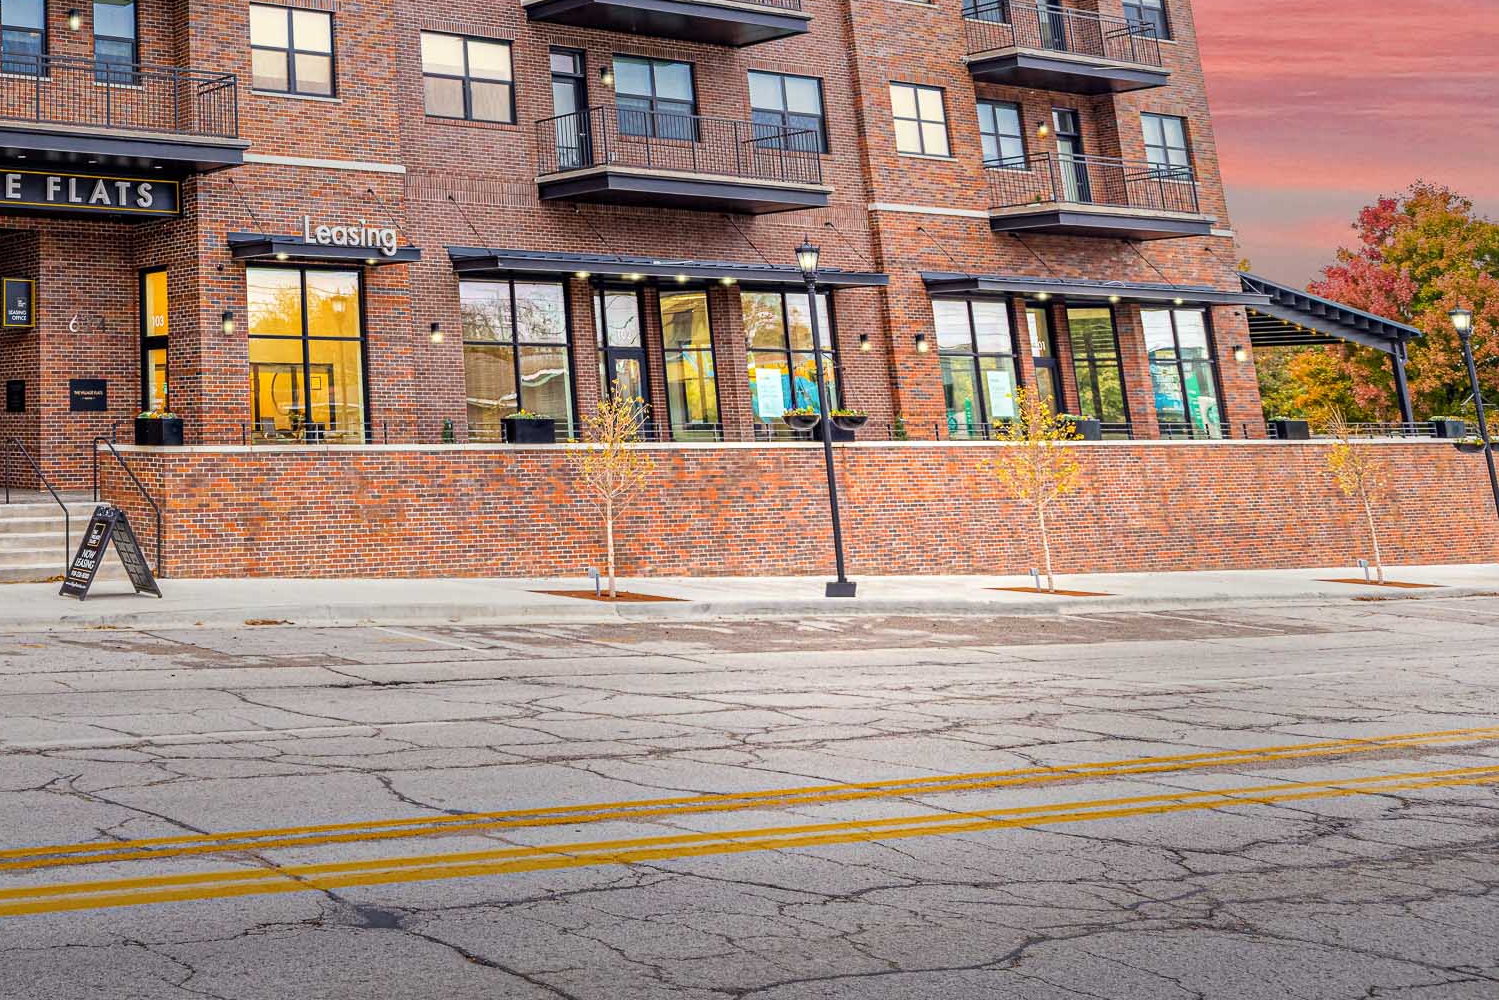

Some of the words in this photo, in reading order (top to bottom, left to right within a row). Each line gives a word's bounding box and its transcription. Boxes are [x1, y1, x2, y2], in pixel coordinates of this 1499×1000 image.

[46, 176, 154, 208] FLATS
[304, 215, 397, 257] Leasing
[152, 315, 165, 327] 103
[82, 549, 97, 560] NOW
[74, 557, 95, 570] LEASING
